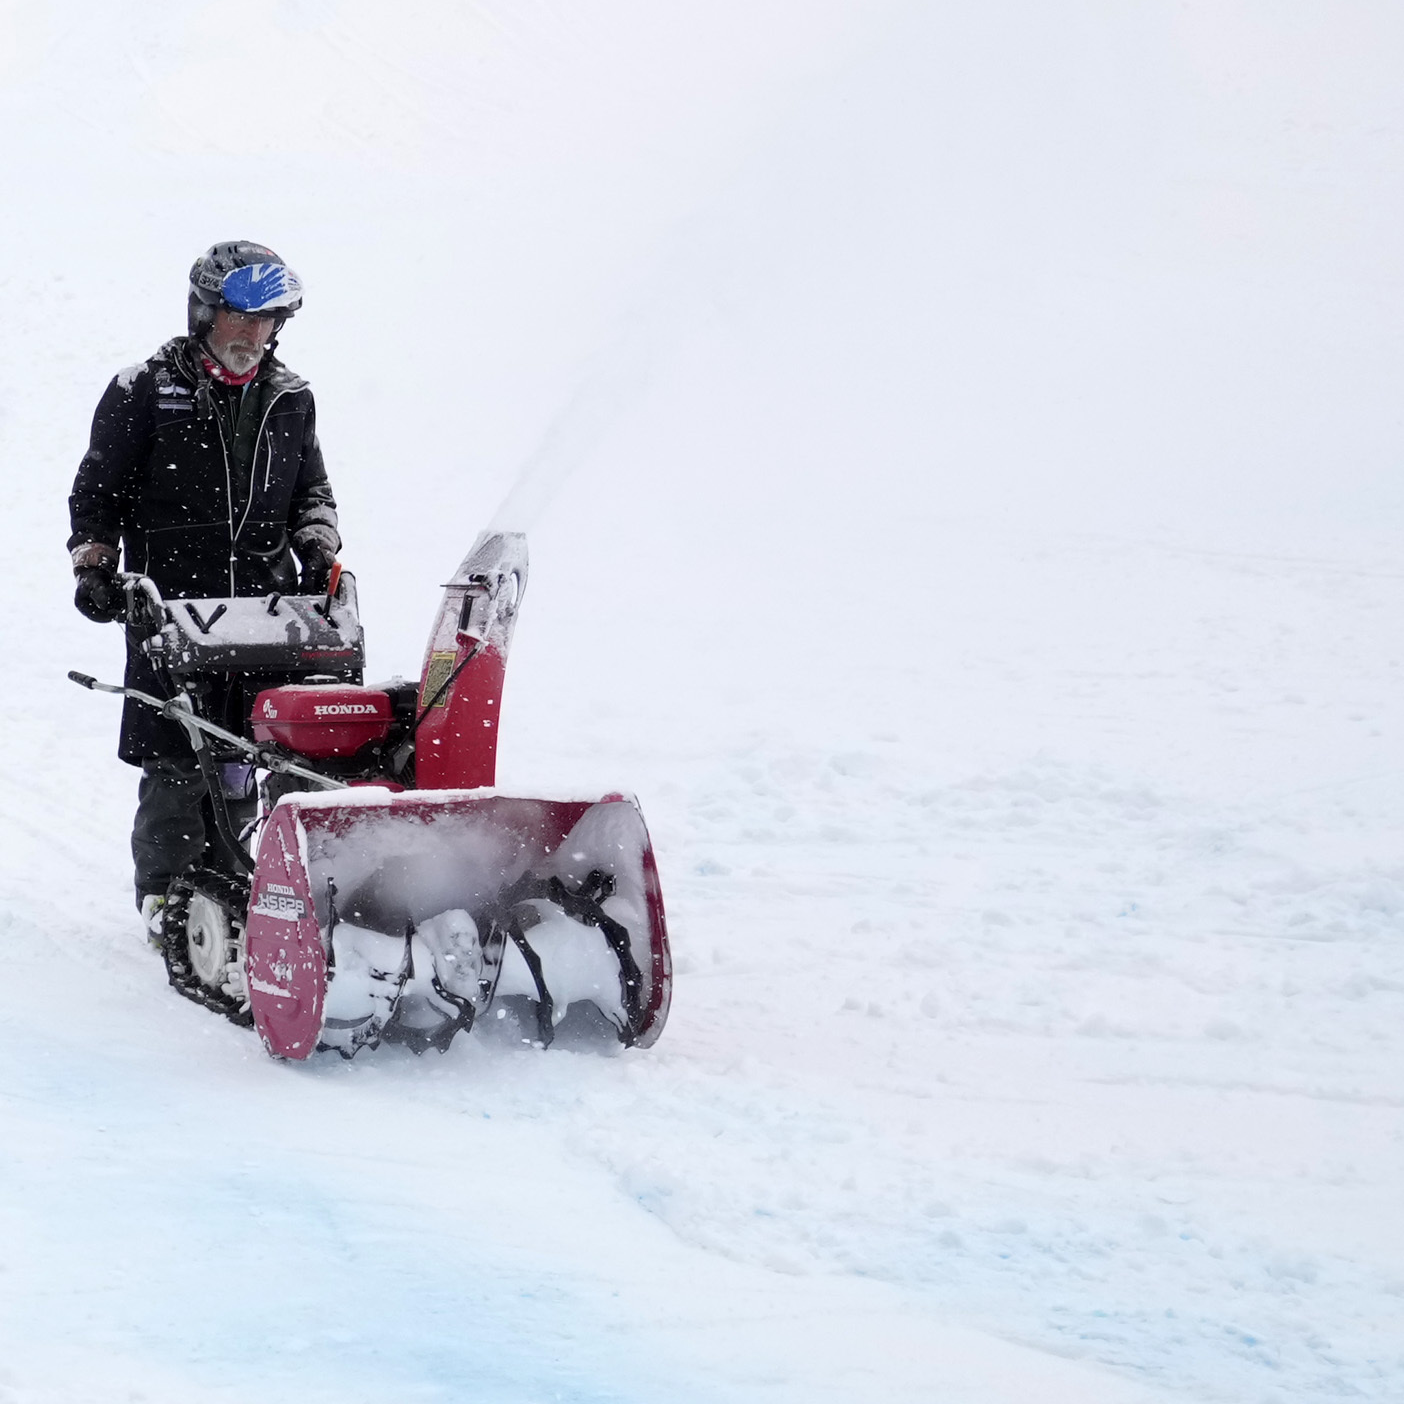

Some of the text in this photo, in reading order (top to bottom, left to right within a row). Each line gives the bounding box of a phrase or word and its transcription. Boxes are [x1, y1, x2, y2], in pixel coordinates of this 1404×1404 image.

[314, 703, 378, 715] HONDA
[267, 882, 295, 896] HONDA
[258, 893, 305, 914] HS828
